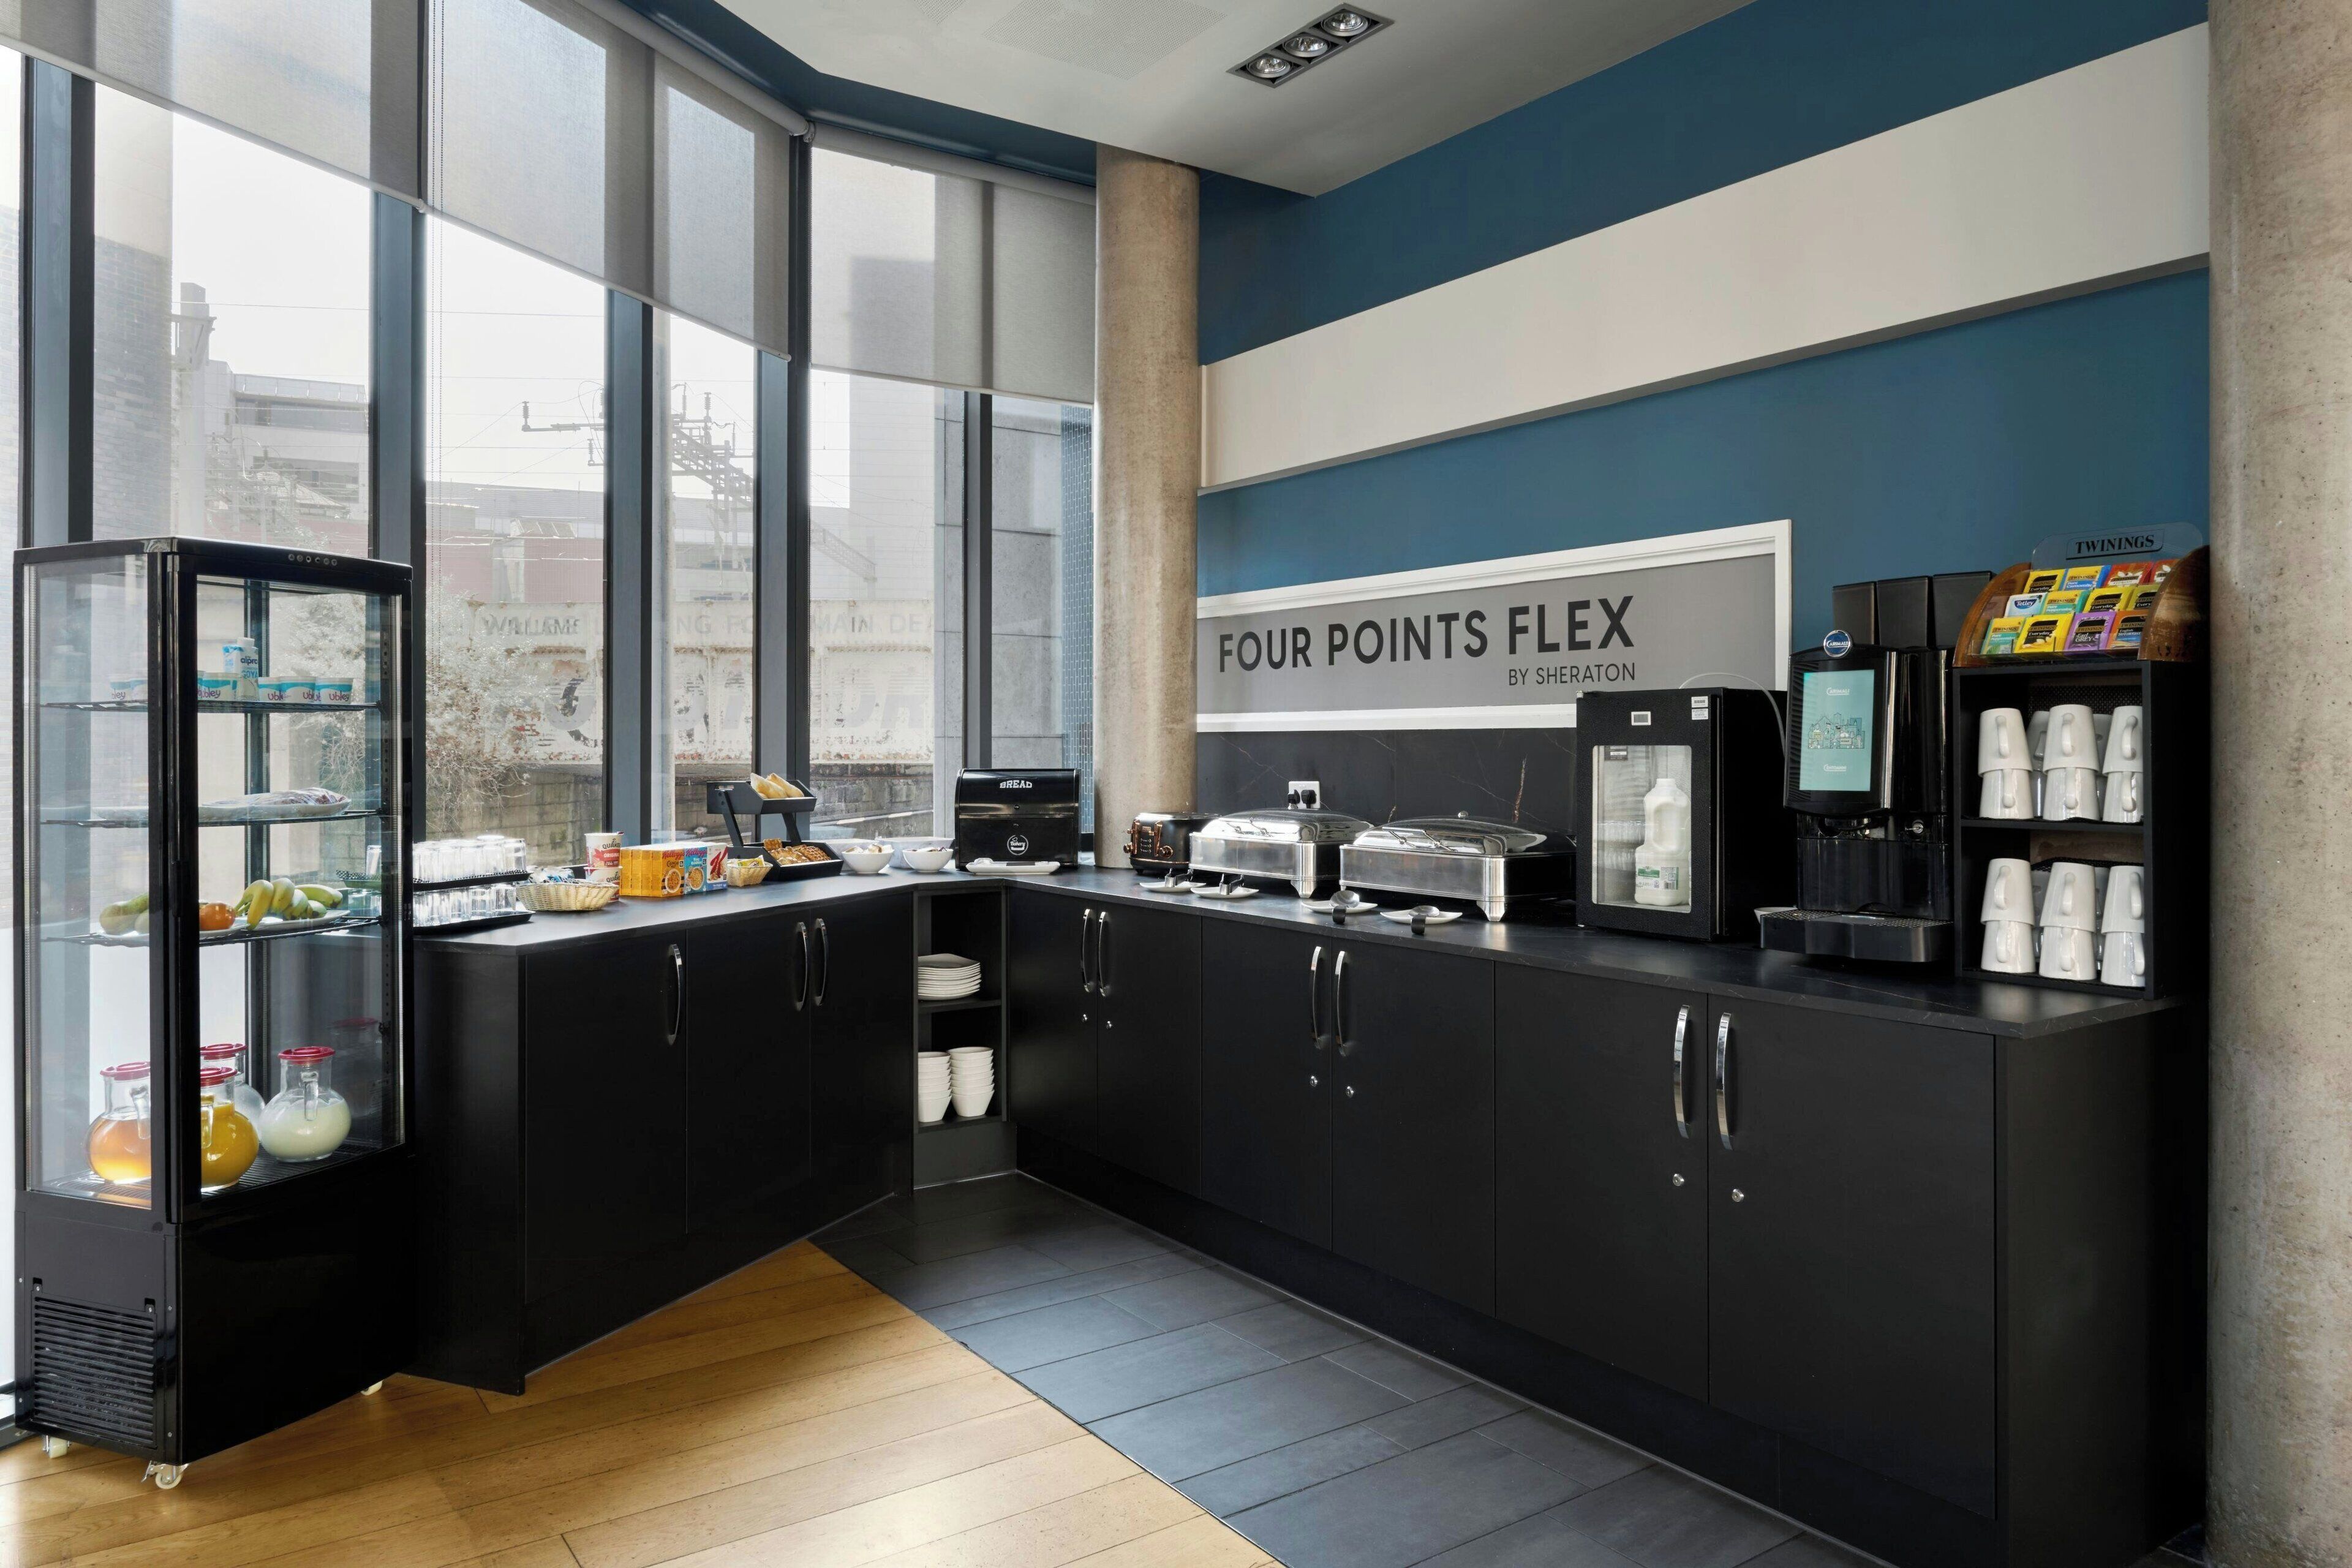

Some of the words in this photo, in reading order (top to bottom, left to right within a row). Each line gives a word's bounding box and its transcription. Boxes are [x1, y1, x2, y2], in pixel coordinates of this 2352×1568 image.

[2075, 535, 2154, 554] TWININGS
[1219, 627, 1312, 673] FOUR
[1329, 610, 1488, 666] POINTS
[1509, 595, 1635, 655] FLEX
[1509, 668, 1529, 686] BY
[1536, 662, 1635, 685] SHERATON
[1000, 780, 1033, 788] BREAD
